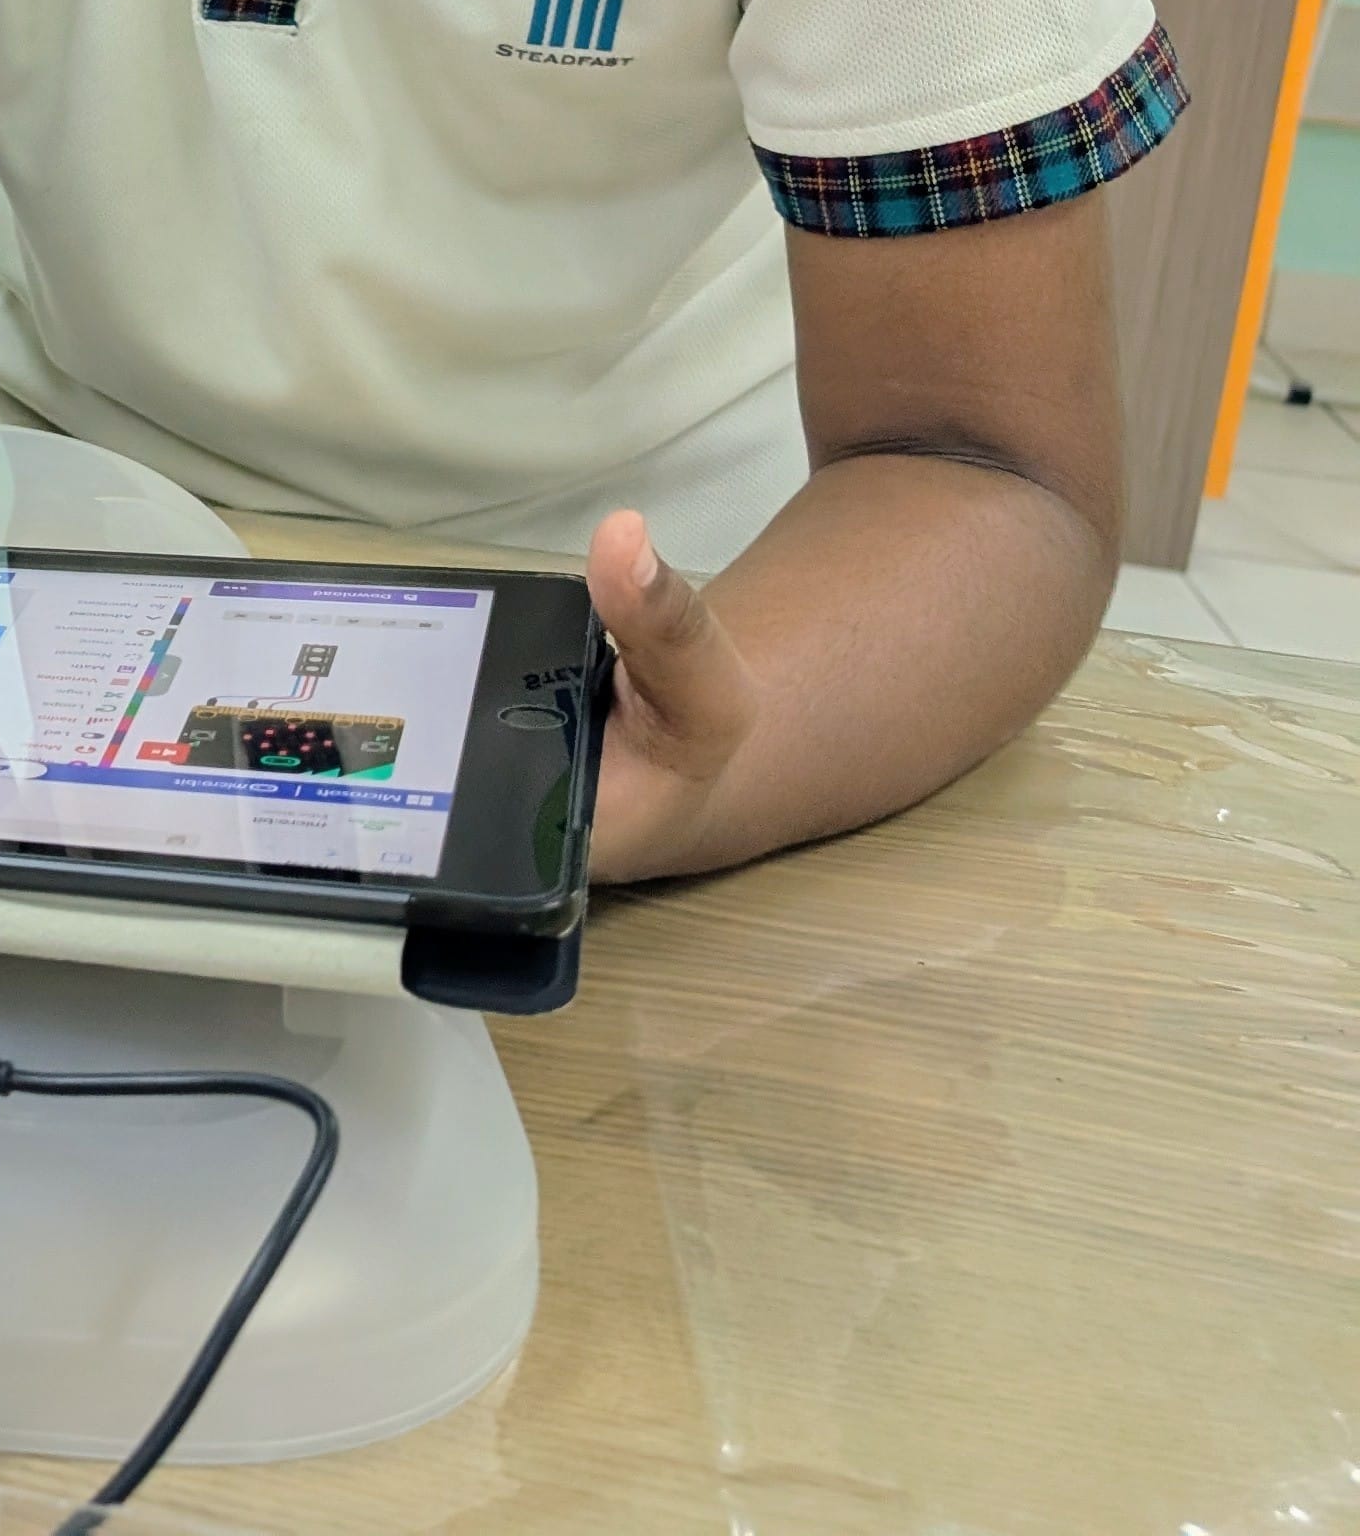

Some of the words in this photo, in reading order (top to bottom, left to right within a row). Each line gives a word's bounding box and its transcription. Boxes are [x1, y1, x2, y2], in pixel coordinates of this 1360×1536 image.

[496, 43, 634, 67] STEADFAST
[313, 590, 391, 600] Download
[173, 778, 249, 790] micro:bit
[318, 789, 402, 802] Microsoft
